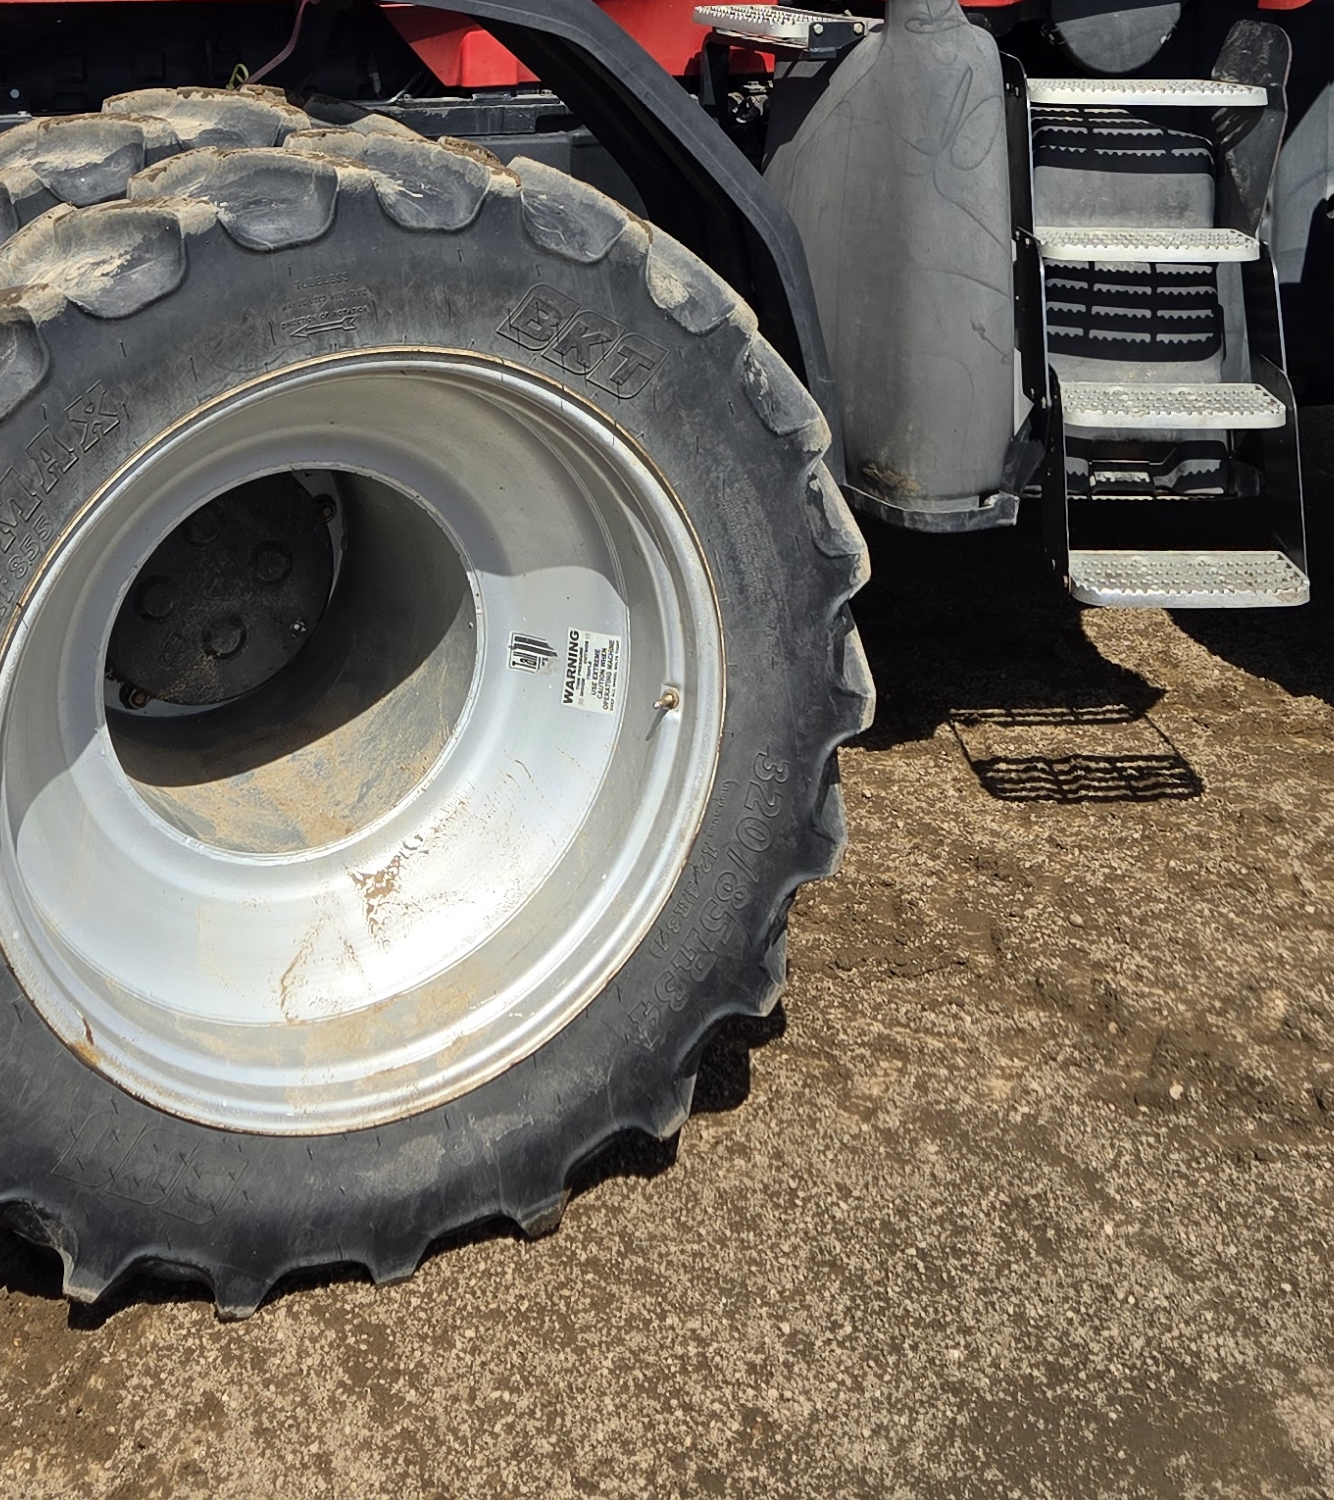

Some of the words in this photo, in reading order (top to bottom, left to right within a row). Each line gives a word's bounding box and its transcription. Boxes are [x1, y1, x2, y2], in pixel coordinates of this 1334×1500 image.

[293, 271, 349, 290] TUBELESS
[503, 289, 661, 393] BKT
[6, 514, 56, 581] 855
[563, 629, 580, 704] WARNING
[592, 648, 601, 680] EXTREME
[606, 639, 615, 670] MACHINE
[590, 681, 598, 696] USE
[596, 669, 605, 699] CAUTION
[602, 671, 612, 711] OPERATING
[627, 750, 791, 1053] 320/85R34
